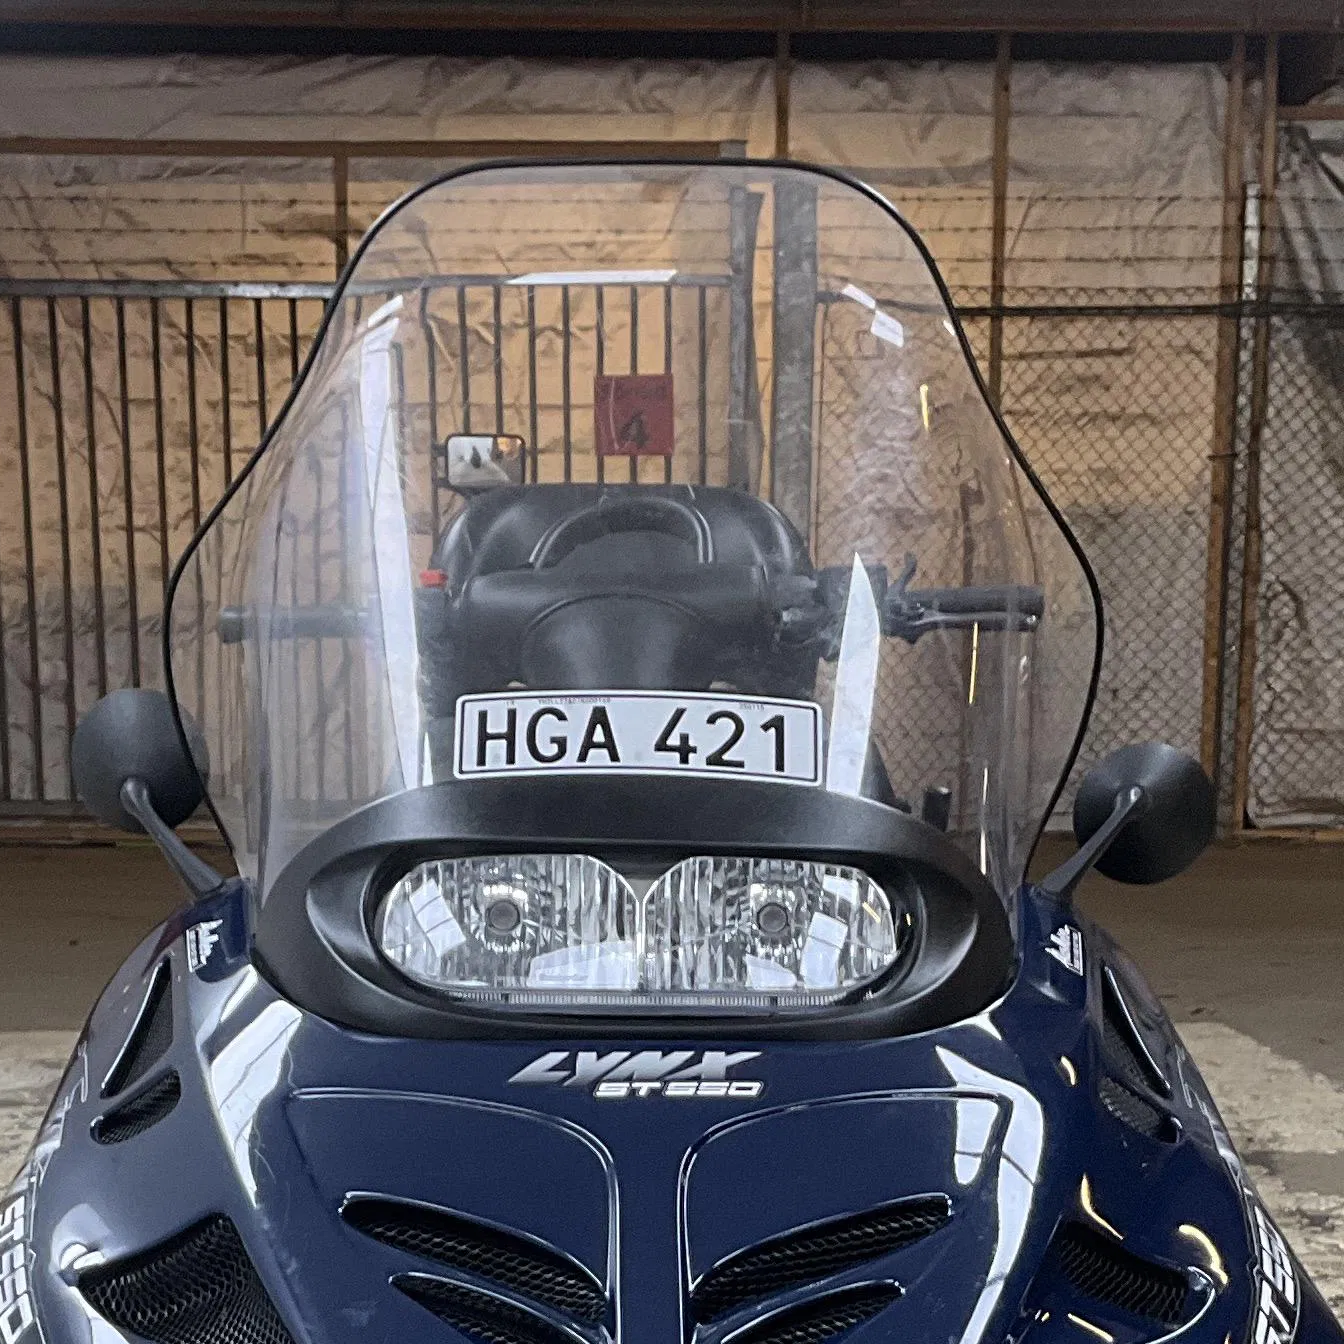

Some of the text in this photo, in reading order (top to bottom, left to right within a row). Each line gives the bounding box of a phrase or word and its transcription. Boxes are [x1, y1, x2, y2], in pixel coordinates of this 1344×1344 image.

[619, 410, 649, 448] 4
[476, 705, 786, 772] HGA 421
[507, 1051, 762, 1087] LYNX
